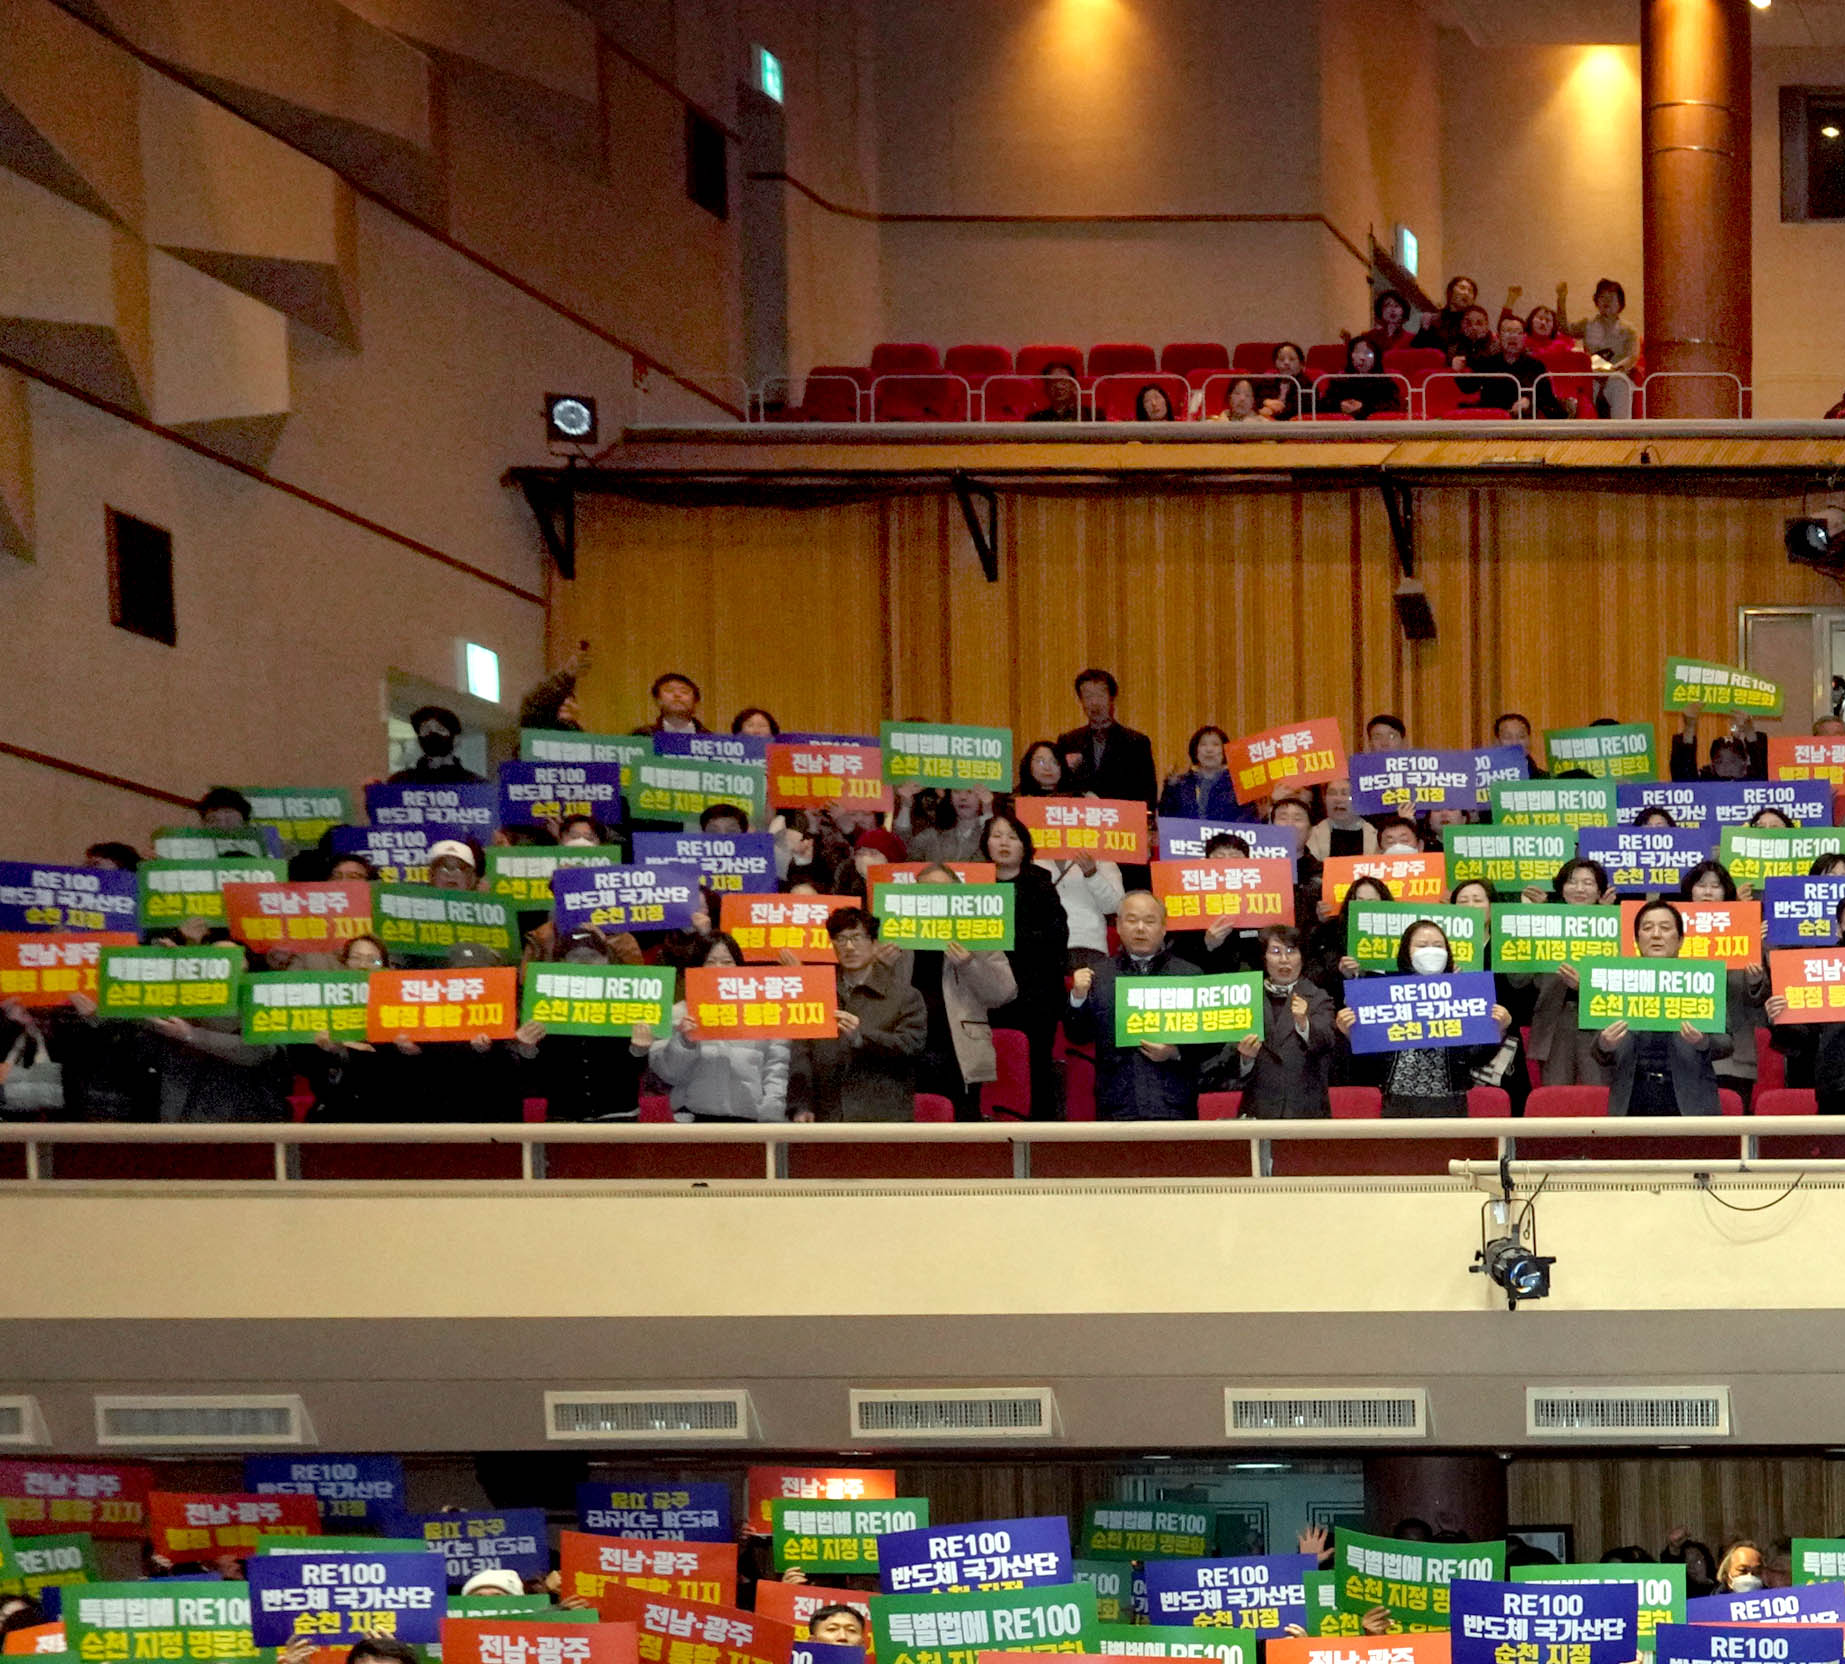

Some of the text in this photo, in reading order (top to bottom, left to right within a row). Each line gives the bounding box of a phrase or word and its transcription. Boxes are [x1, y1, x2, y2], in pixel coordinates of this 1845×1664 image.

[1659, 971, 1714, 994] RE100
[1197, 984, 1251, 1006] RE100
[1590, 994, 1714, 1019] 순천 지정 명문화
[1127, 1008, 1251, 1033] 순천 지정 명문화
